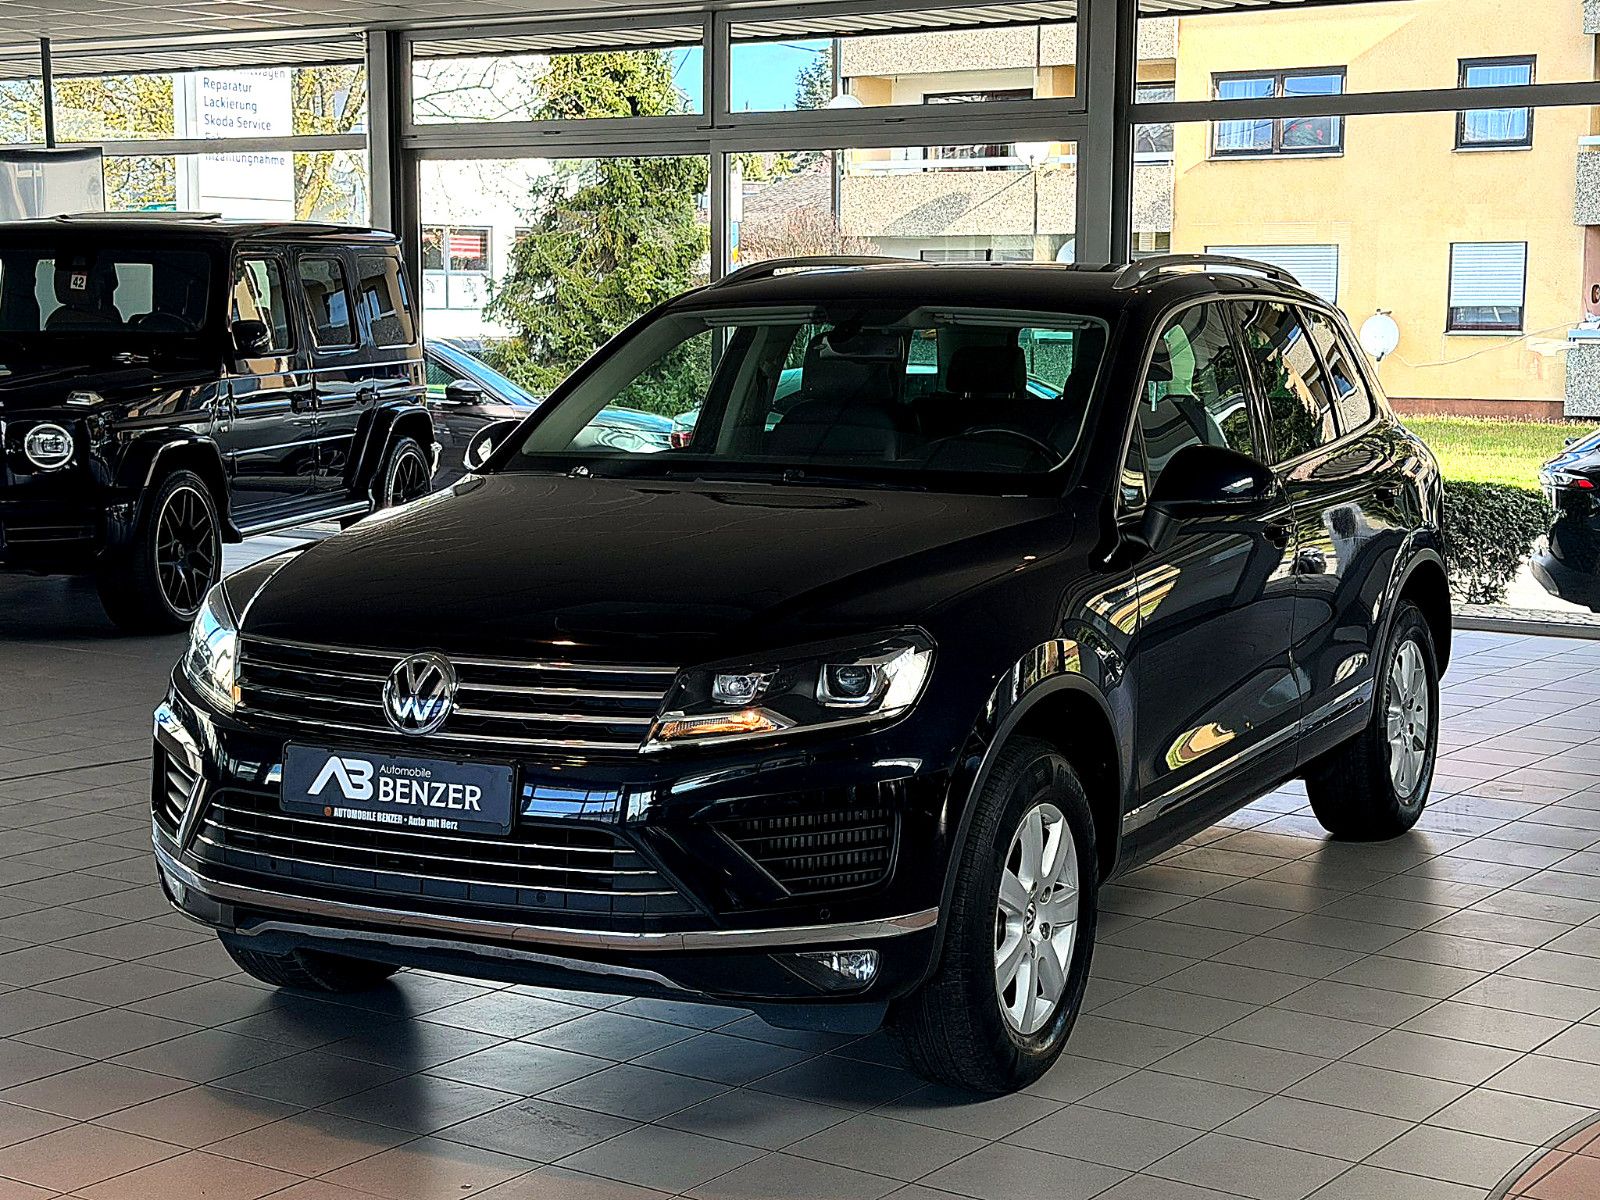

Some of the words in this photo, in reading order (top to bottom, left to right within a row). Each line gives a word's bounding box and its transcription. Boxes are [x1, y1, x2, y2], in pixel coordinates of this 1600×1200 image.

[203, 77, 252, 92] Reparatur
[203, 96, 257, 115] Lackierung
[204, 113, 234, 127] Skoda
[236, 116, 272, 131] Service
[73, 276, 84, 288] 42
[379, 764, 431, 779] Automobile
[378, 777, 482, 812] BENZER
[333, 807, 377, 822] AUTOMOBILE
[376, 811, 403, 825] BENZER
[407, 815, 426, 827] Auto
[426, 817, 440, 829] mit
[440, 818, 459, 831] Herz
